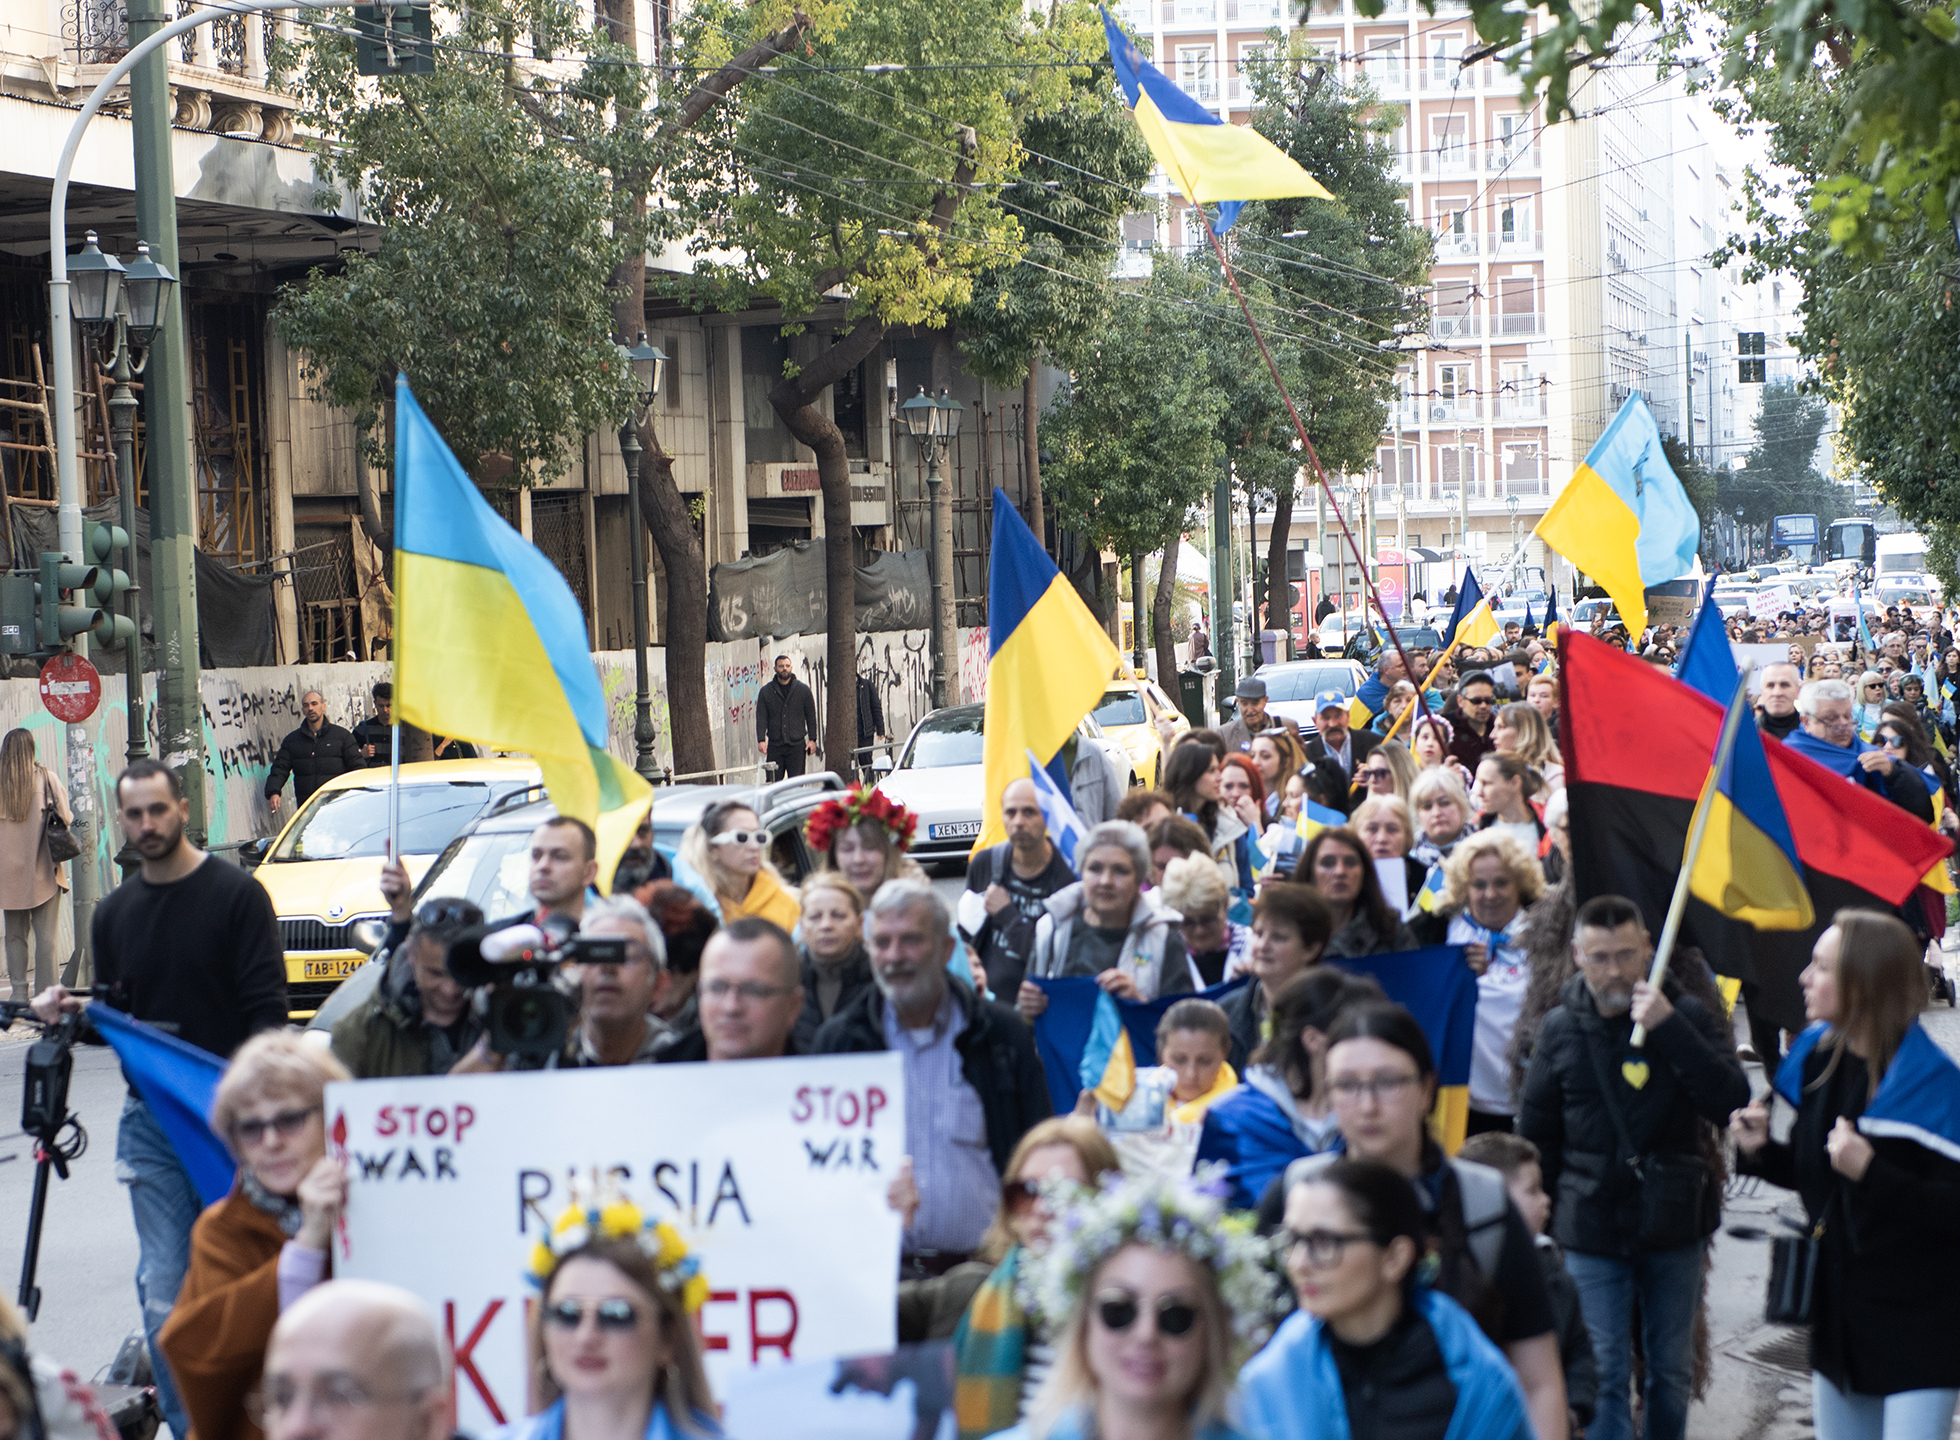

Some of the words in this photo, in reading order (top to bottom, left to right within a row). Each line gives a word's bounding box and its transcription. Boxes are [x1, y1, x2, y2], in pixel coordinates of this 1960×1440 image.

[938, 823, 982, 836] XEN-317
[376, 1105, 475, 1142] STOP
[790, 1086, 887, 1128] STOP
[354, 1148, 457, 1180] WAR
[804, 1137, 880, 1171] WAR
[518, 1160, 753, 1234] RSIA
